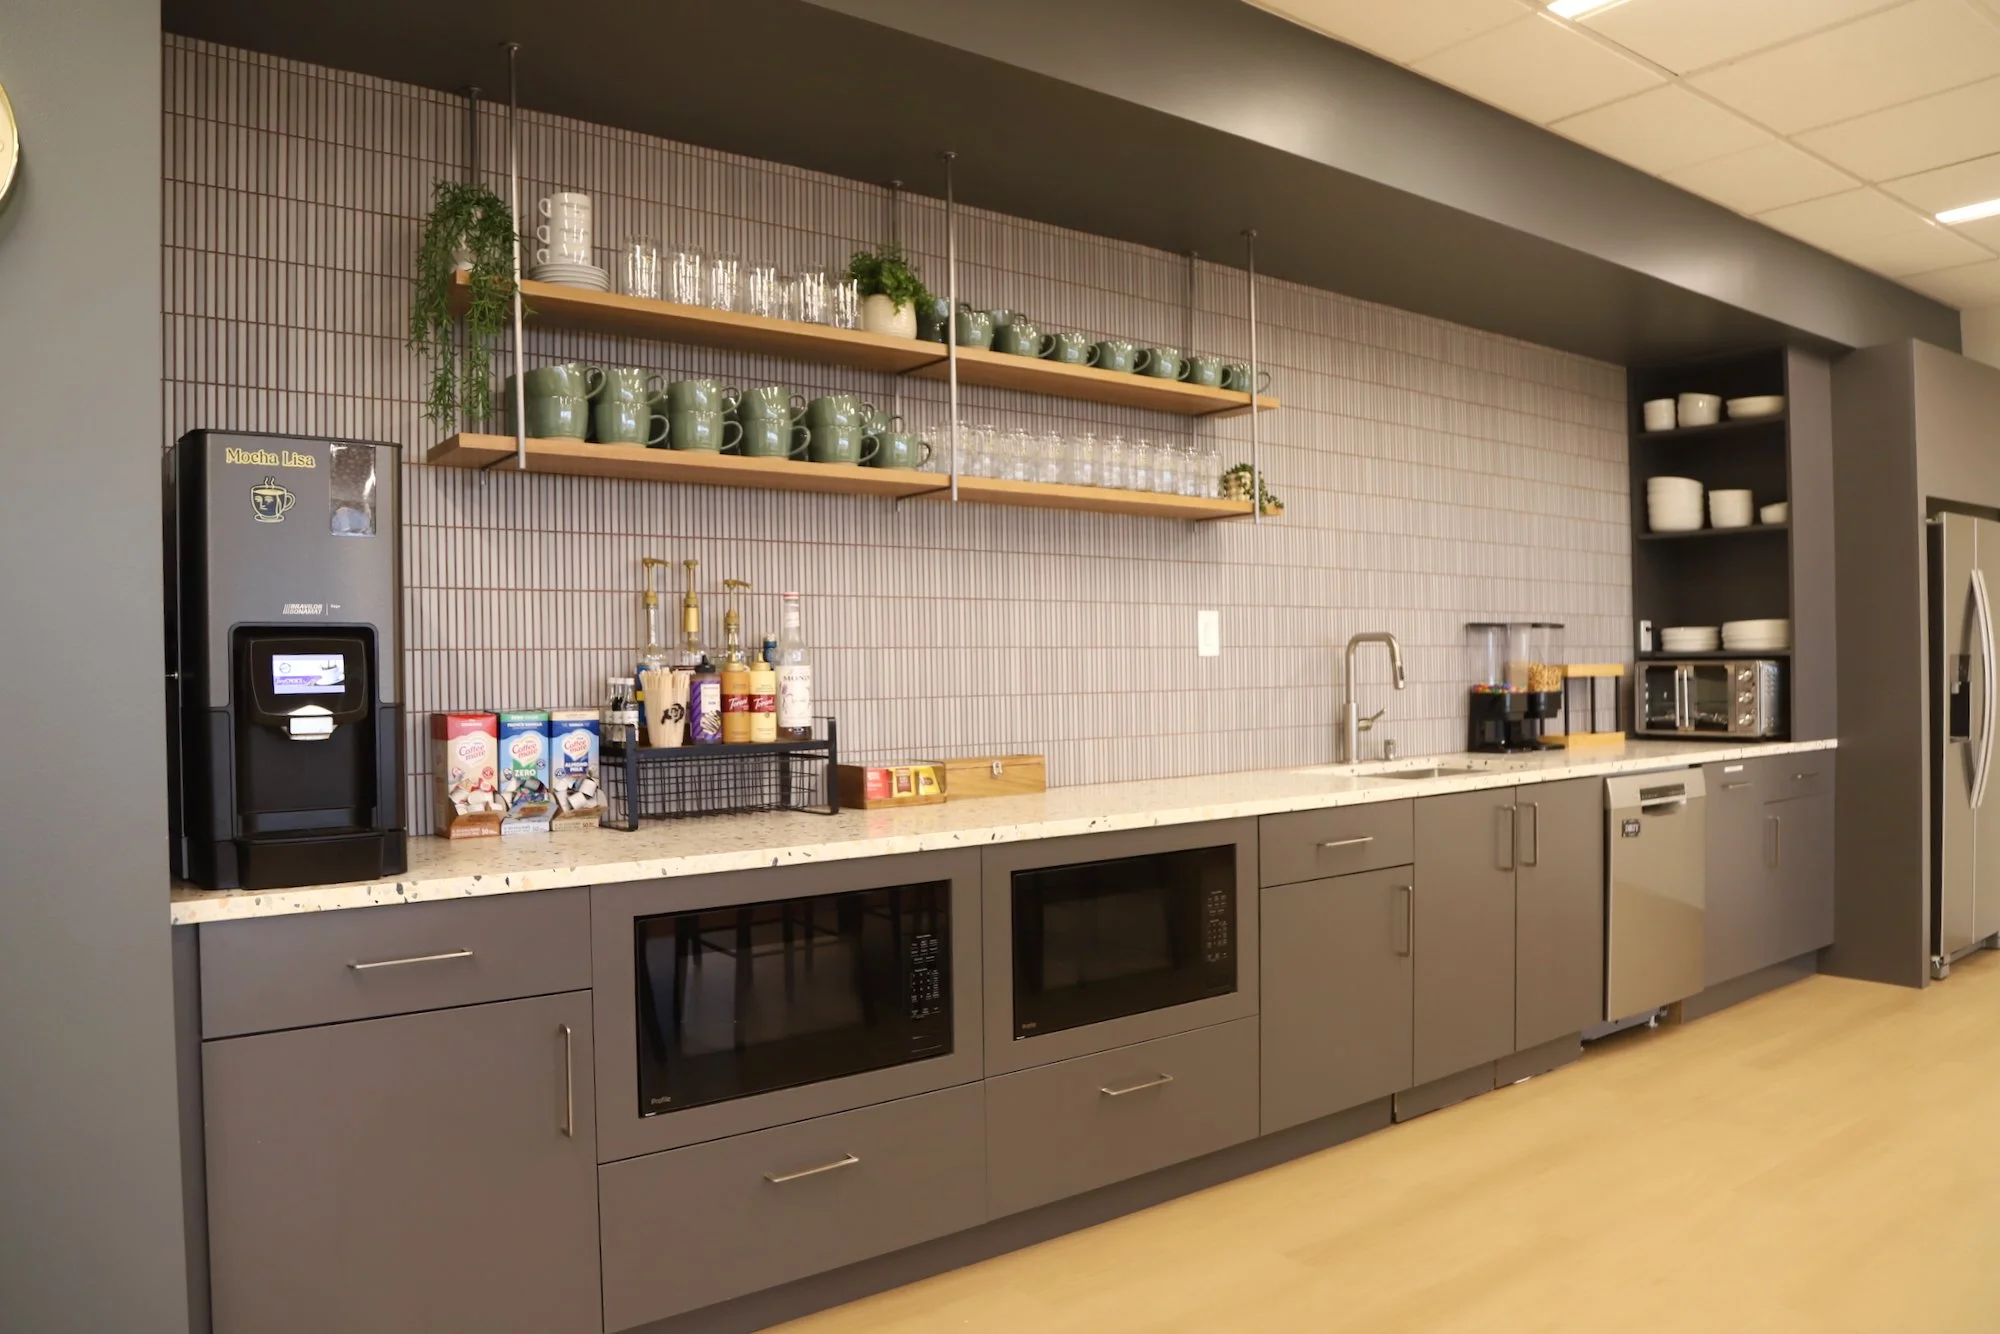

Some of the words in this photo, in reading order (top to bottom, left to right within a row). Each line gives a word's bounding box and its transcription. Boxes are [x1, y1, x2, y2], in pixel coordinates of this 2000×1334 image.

[225, 447, 279, 465] Mocha
[281, 450, 316, 468] Lisa
[515, 769, 536, 777] ZERO
